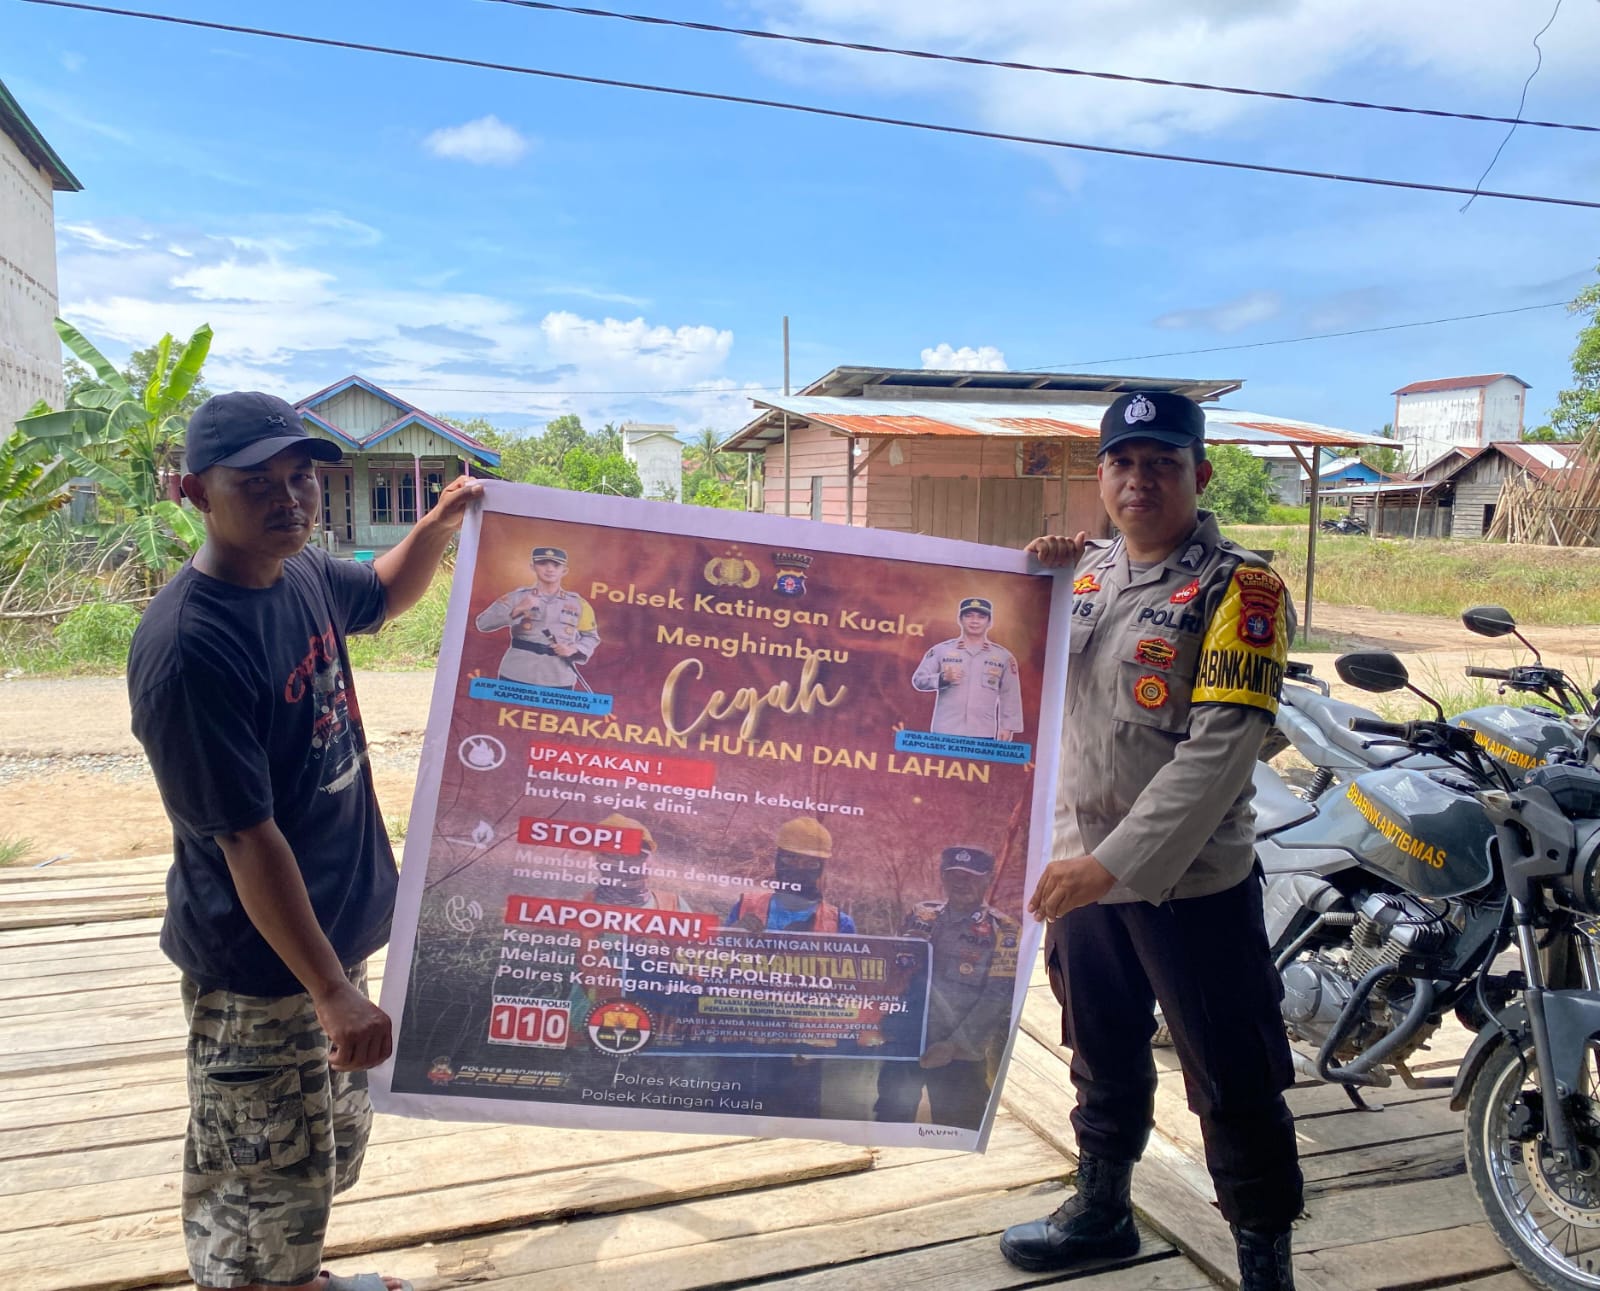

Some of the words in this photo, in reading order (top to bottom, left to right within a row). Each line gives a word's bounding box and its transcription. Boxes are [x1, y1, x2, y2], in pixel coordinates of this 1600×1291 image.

[590, 581, 685, 611] Polsek
[694, 593, 829, 628] Katingan
[840, 610, 926, 637] Kuala
[1138, 607, 1201, 633] POLRI
[657, 624, 850, 664] Menghimbau
[494, 690, 540, 704] KAPOLRES
[542, 697, 590, 710] KATINGAN
[661, 653, 849, 742] Cegah
[497, 707, 688, 750] KEBAKARAN
[699, 733, 802, 762] HUTAN
[813, 746, 877, 771] DAN
[887, 754, 990, 783] LAHAN
[530, 747, 651, 774] UPAYAKAN
[657, 761, 663, 775] !
[902, 740, 945, 750] KAPOLSEK
[948, 745, 994, 756] KATINGAN
[996, 750, 1025, 759] KUALA
[525, 782, 586, 802] hutan
[593, 793, 647, 811] sejak
[653, 799, 699, 816] dini.
[527, 765, 618, 789] Lakukan
[624, 776, 749, 804] Pencegahan
[755, 791, 865, 816] kebakaran
[530, 822, 624, 849] STOP!
[1346, 782, 1447, 869] BHABINKAMTIBMAS
[513, 866, 627, 888] membakar.
[514, 850, 612, 873] Membuka
[619, 860, 677, 879] Lahan
[684, 866, 753, 889] dengan
[760, 877, 802, 892] cara
[518, 902, 702, 939] LAPORKAN!
[503, 929, 582, 949] Kepada
[587, 938, 670, 957] petugas
[676, 945, 762, 965] terdekat
[745, 938, 823, 952] KATINGAN
[824, 941, 871, 954] KUALA
[500, 947, 576, 966] Melalui
[582, 954, 635, 971] CALL
[640, 960, 724, 979] CENTER
[730, 968, 793, 986] POLRI
[799, 974, 833, 990] 110
[494, 996, 539, 1006] LAYANAN
[541, 1000, 570, 1008] POLISI
[498, 966, 563, 983] Polres
[570, 972, 661, 992] Katingan
[664, 979, 703, 996] jika
[708, 985, 831, 1006] menemukan
[838, 996, 875, 1011] titik
[879, 1000, 910, 1016] api.
[496, 1010, 565, 1039] 110
[614, 1073, 664, 1086] Polres
[669, 1076, 741, 1091] Katingan
[582, 1089, 636, 1102] Polsek
[640, 1093, 714, 1108] Katingan
[719, 1097, 763, 1110] Kuala
